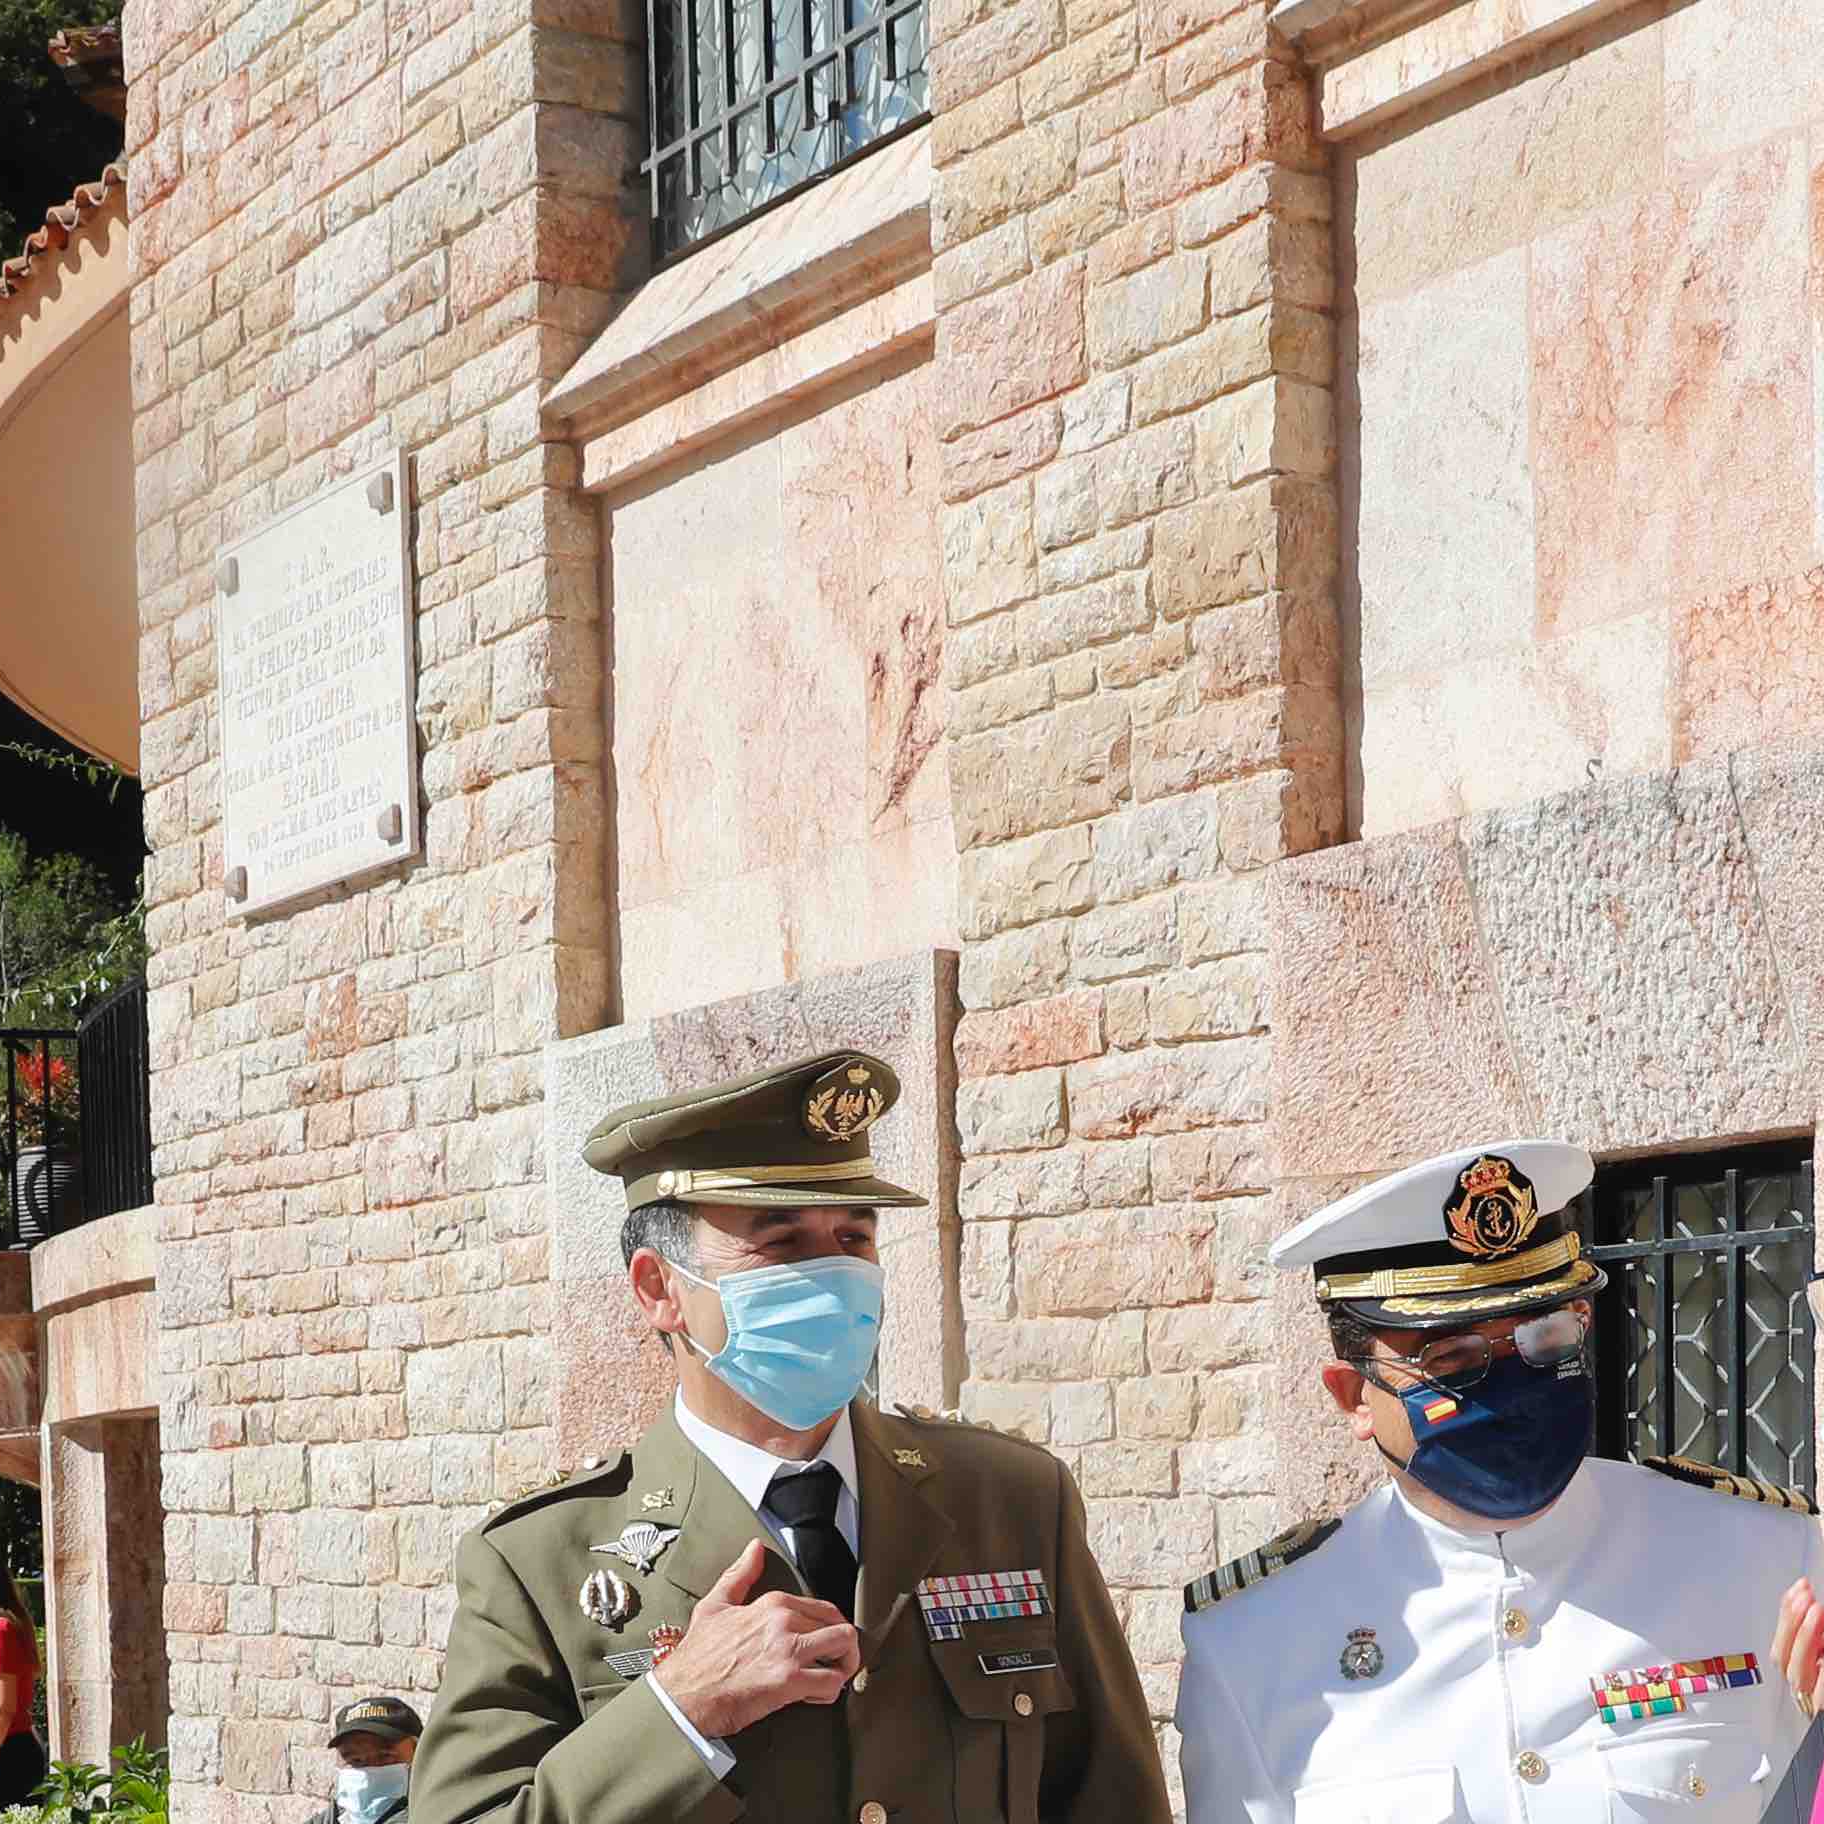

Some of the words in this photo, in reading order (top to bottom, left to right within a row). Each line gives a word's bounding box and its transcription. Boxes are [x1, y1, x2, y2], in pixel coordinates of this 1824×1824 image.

[306, 587, 323, 619] DE
[326, 555, 388, 609] ASTURIAS
[257, 629, 308, 681] FELIPE
[311, 618, 332, 656] DE
[368, 630, 386, 660] DE
[267, 679, 356, 746] COVADONGA
[385, 698, 402, 728] DE
